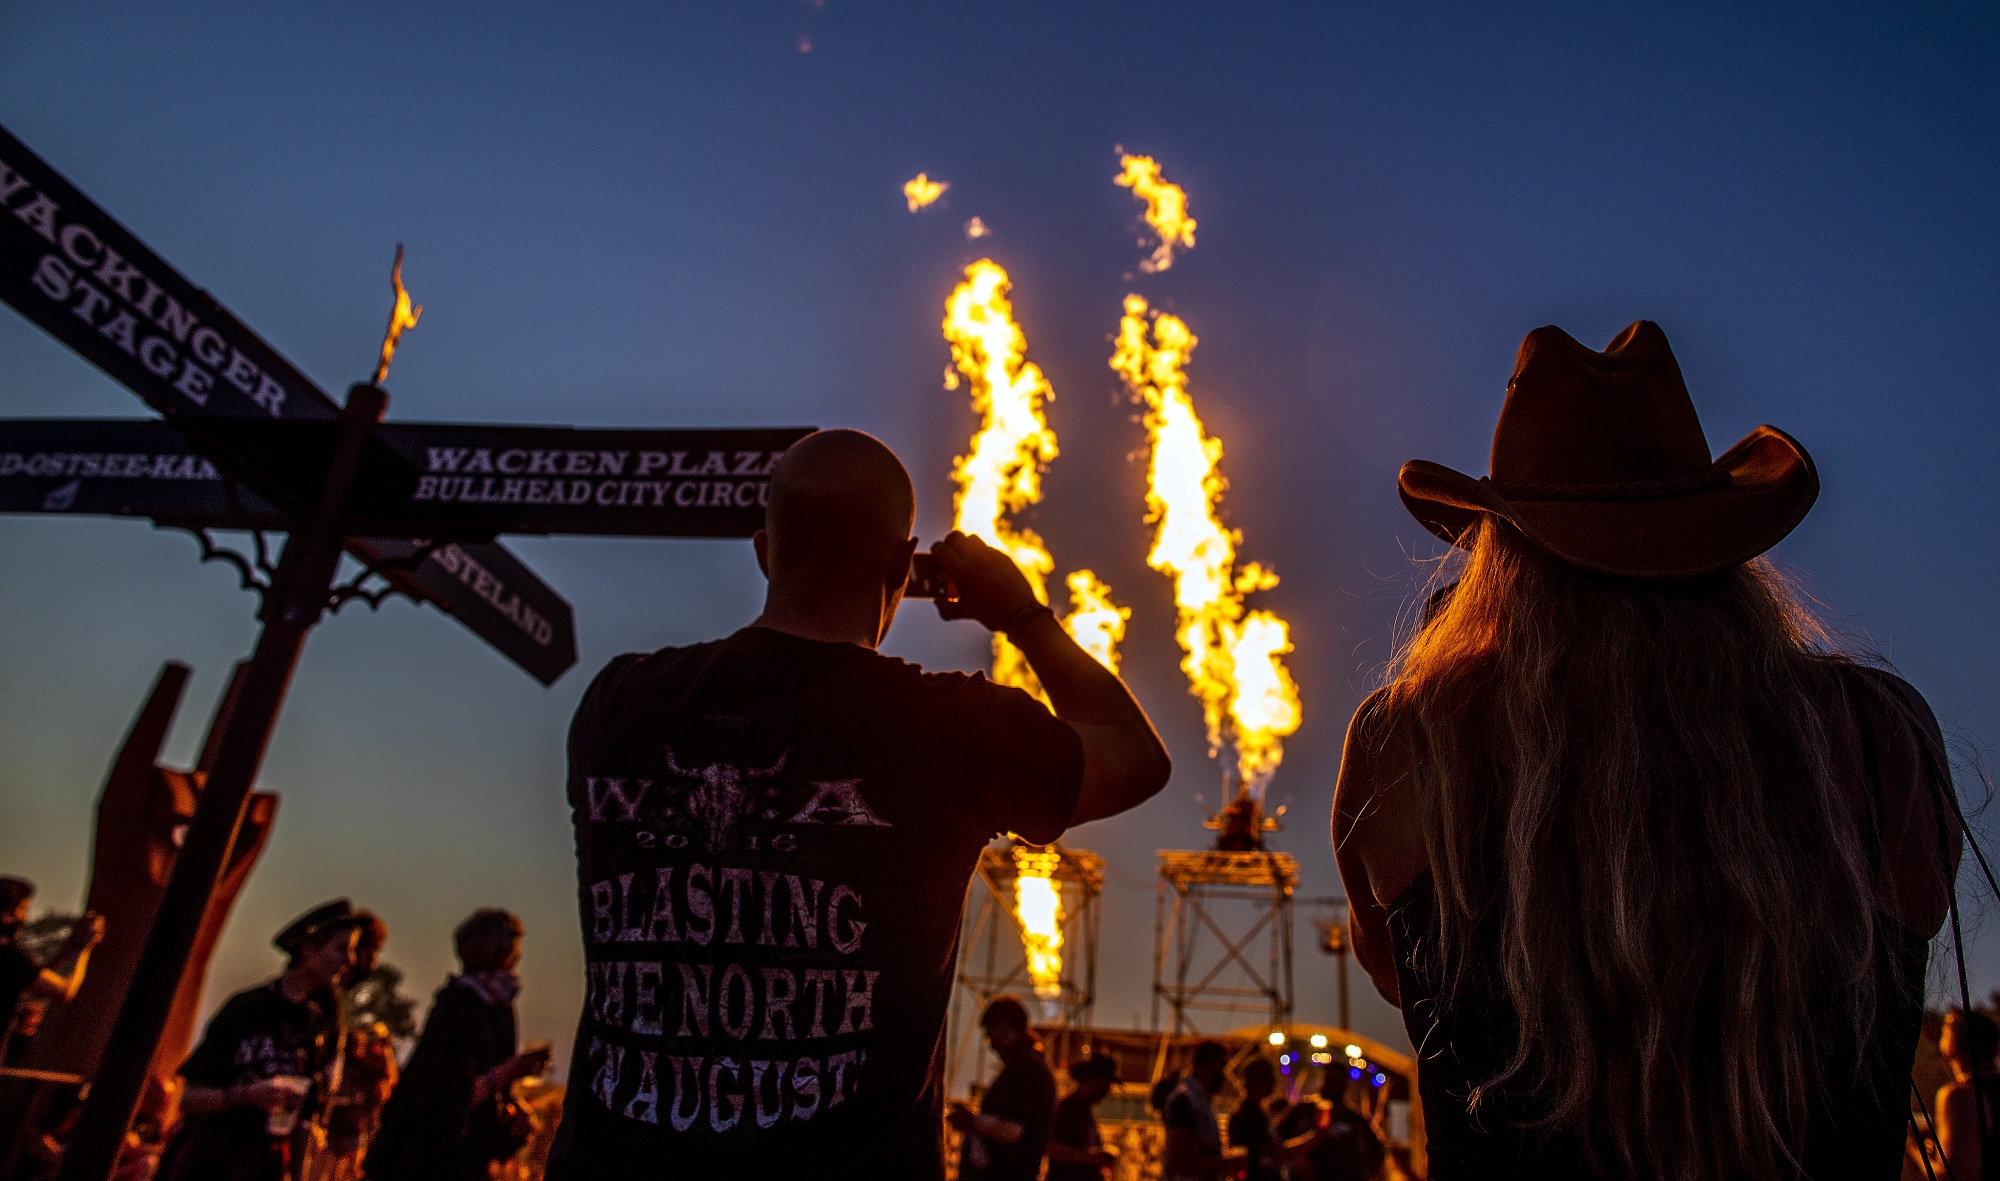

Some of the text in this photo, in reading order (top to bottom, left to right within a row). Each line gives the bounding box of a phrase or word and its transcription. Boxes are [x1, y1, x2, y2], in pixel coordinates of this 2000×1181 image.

[30, 253, 216, 407] STAGE
[412, 475, 593, 506] BULLHEAD
[595, 479, 673, 507] CITY
[426, 446, 630, 476] WACKEN
[589, 861, 869, 955] BLASTING
[675, 962, 881, 1041] NORTH
